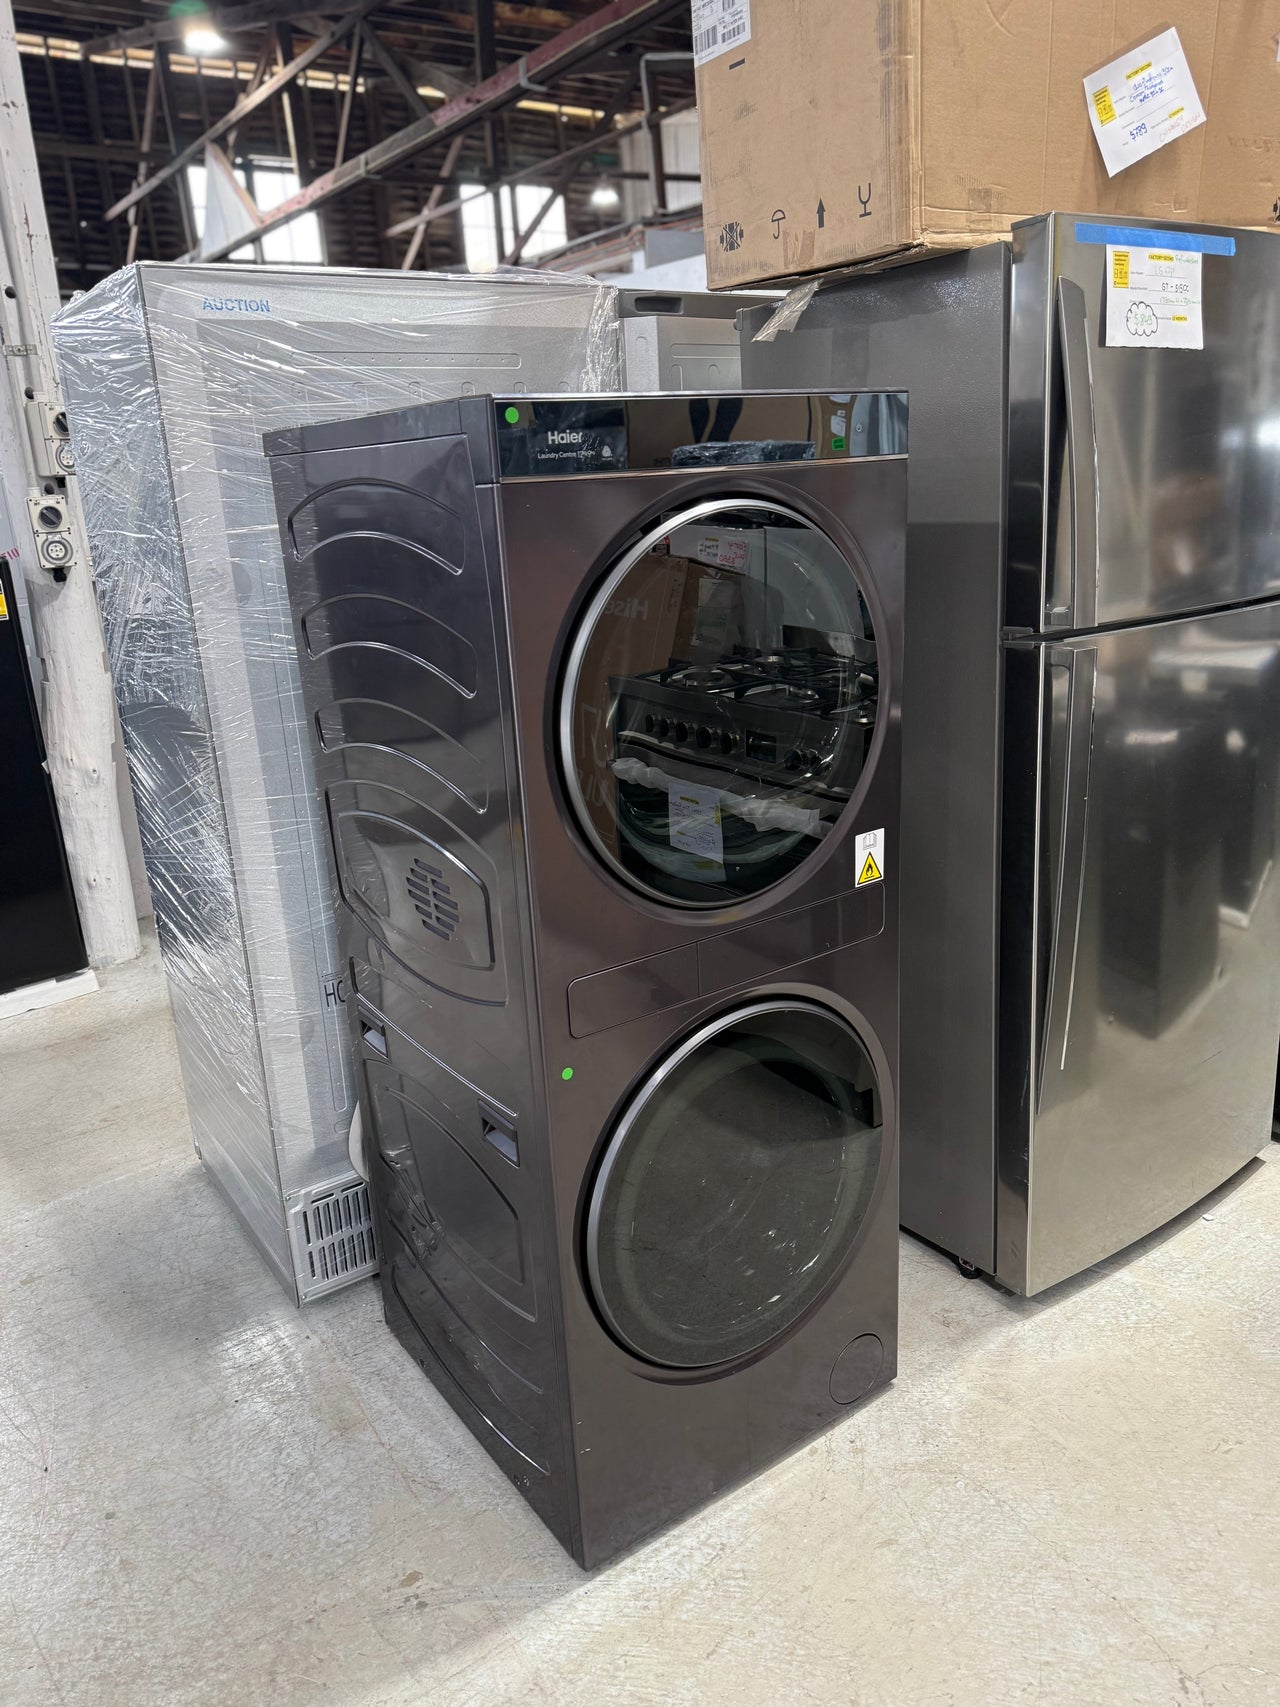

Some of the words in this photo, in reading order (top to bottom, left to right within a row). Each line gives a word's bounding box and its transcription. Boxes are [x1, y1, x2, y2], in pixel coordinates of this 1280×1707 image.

[1129, 122, 1148, 141] $789
[202, 297, 271, 312] AUCTION
[548, 429, 583, 444] Haier
[537, 451, 559, 460] Laundry
[559, 450, 577, 458] Centre
